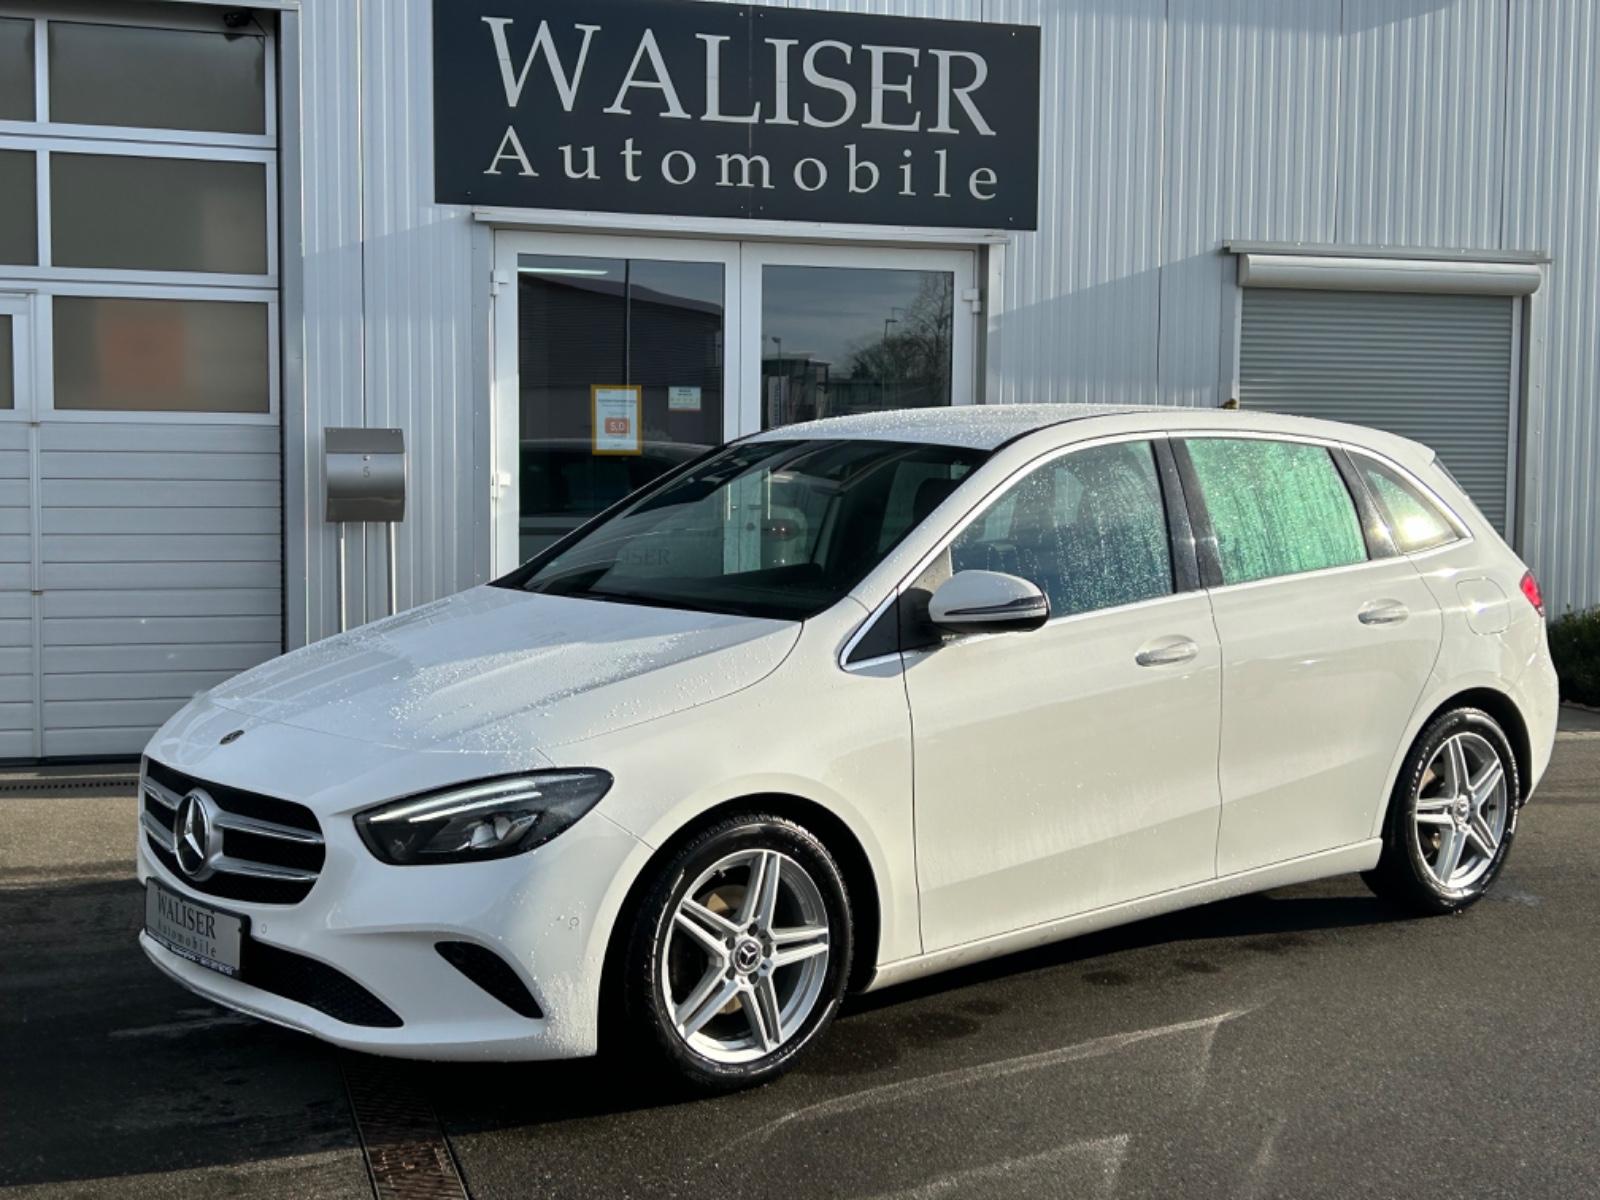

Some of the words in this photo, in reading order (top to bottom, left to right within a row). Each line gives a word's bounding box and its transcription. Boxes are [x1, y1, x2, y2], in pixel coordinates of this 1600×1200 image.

[481, 16, 997, 136] WALISER
[483, 125, 999, 200] Automobile
[362, 465, 370, 478] 5
[158, 890, 216, 939] WALISER
